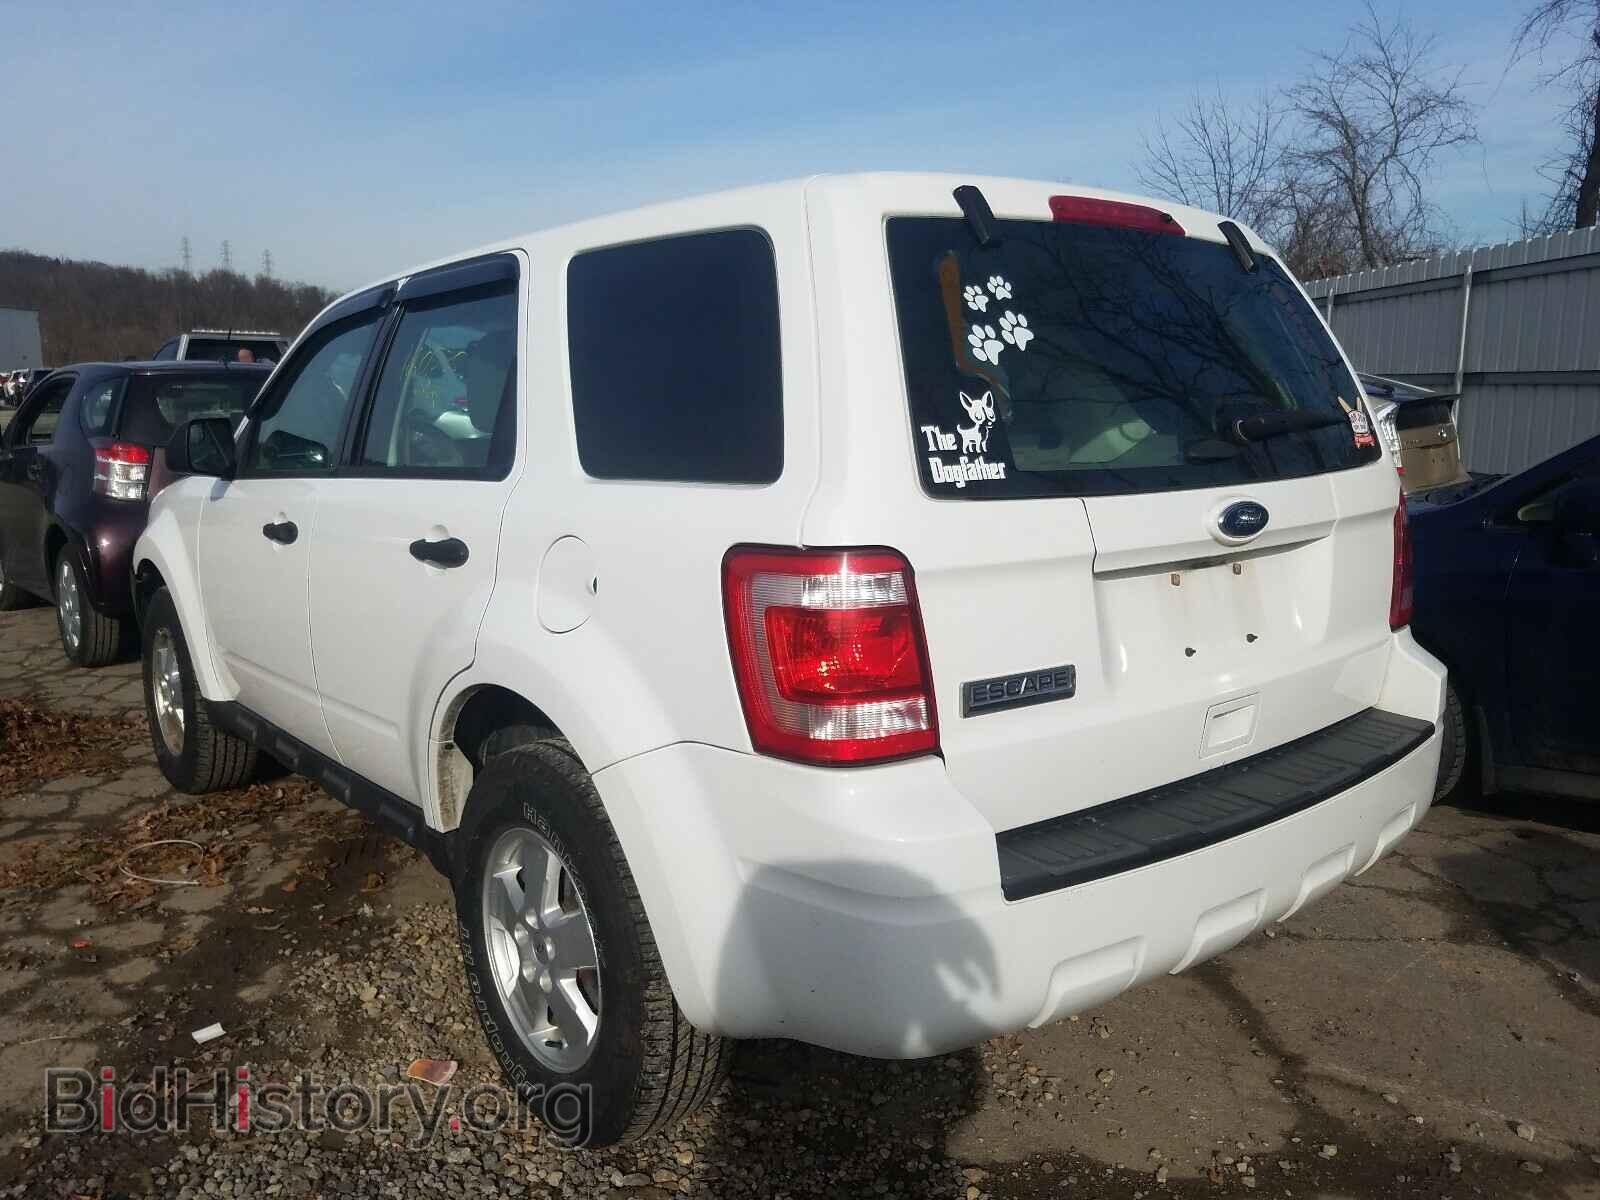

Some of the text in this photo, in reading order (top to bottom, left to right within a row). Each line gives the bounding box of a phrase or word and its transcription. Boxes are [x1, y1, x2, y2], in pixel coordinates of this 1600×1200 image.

[920, 425, 958, 452] The
[928, 455, 1006, 488] Dogfather
[970, 670, 1069, 706] ESCAPE
